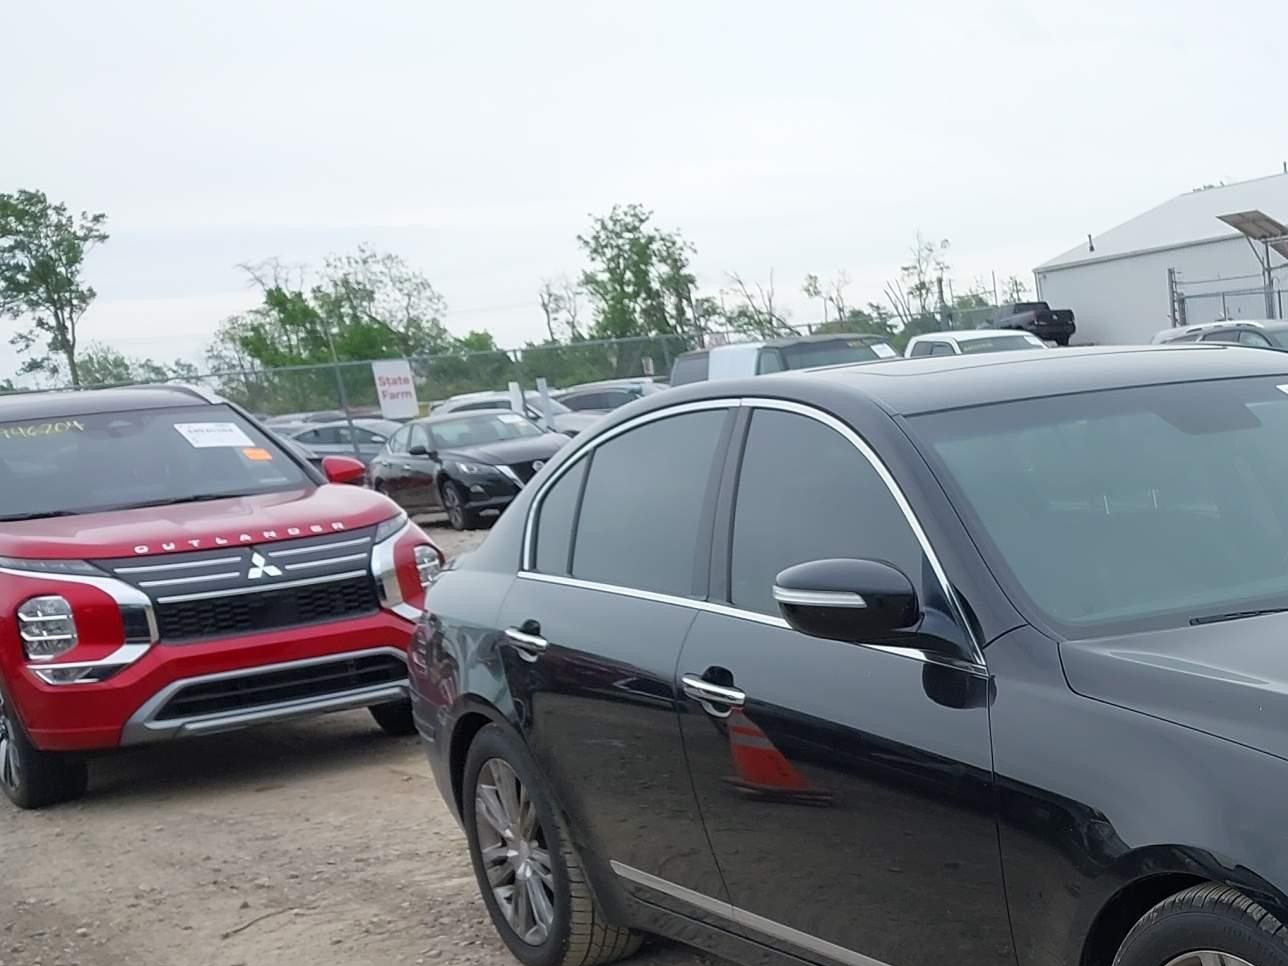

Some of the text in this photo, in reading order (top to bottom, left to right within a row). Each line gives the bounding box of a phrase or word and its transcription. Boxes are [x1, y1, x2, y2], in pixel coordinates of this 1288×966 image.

[378, 376, 410, 386] State
[382, 390, 413, 400] Farm
[134, 521, 345, 554] OUTLANDER
